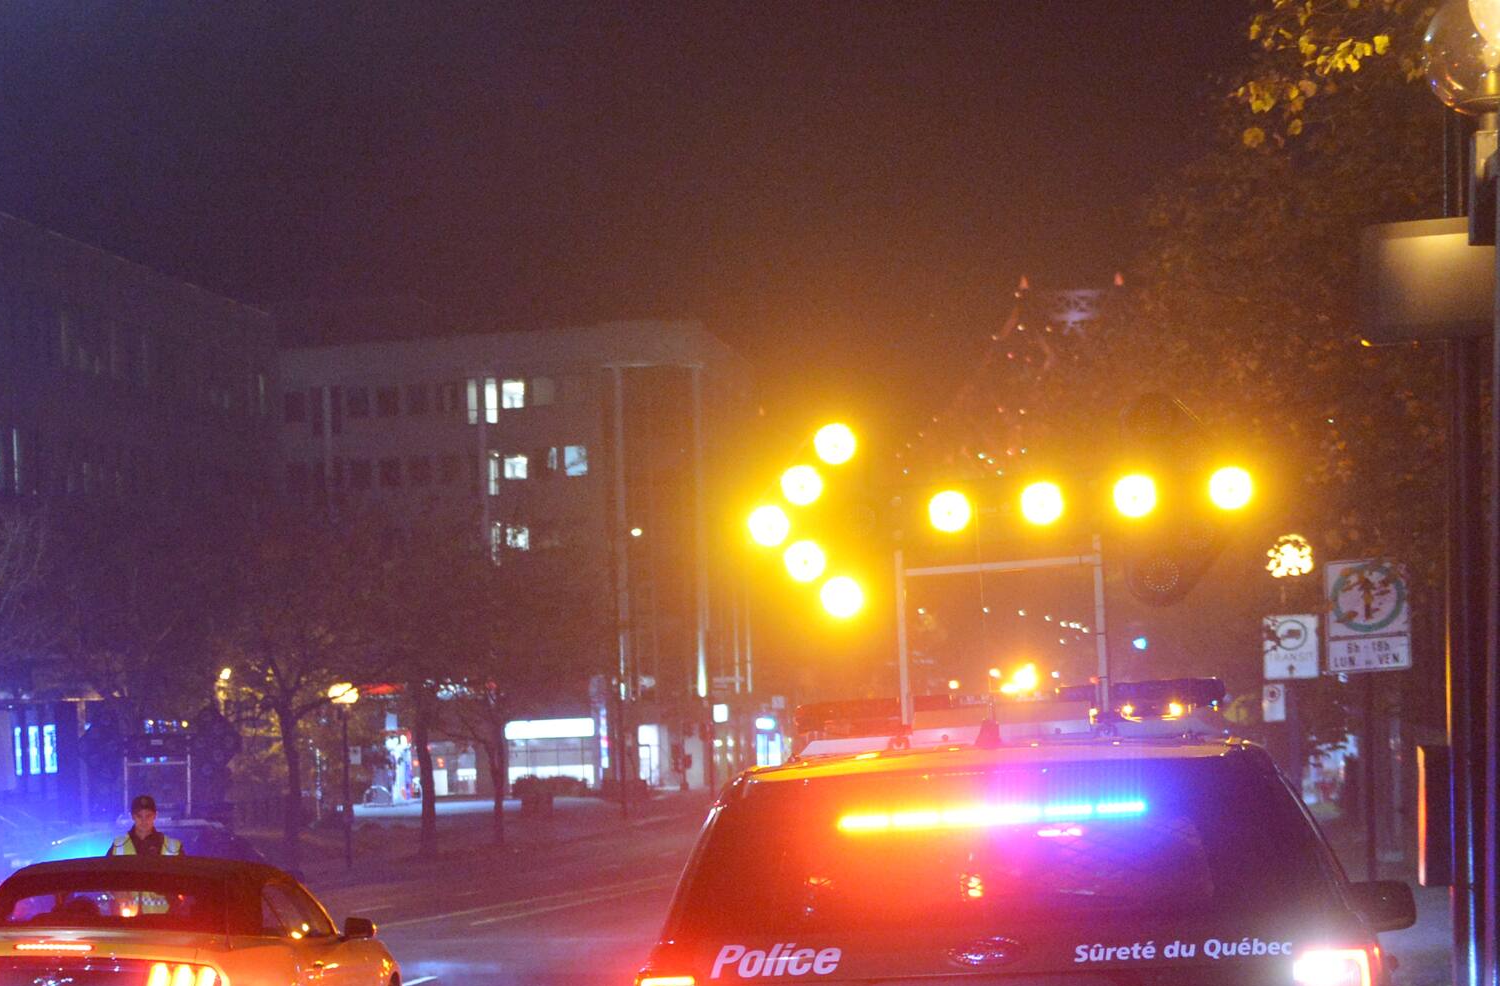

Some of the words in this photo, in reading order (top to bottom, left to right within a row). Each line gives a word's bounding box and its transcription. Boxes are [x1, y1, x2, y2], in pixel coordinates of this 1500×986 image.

[710, 943, 842, 979] Police
[1074, 940, 1156, 963] Sûreté
[1163, 940, 1196, 959] du
[1203, 937, 1293, 959] Québec
